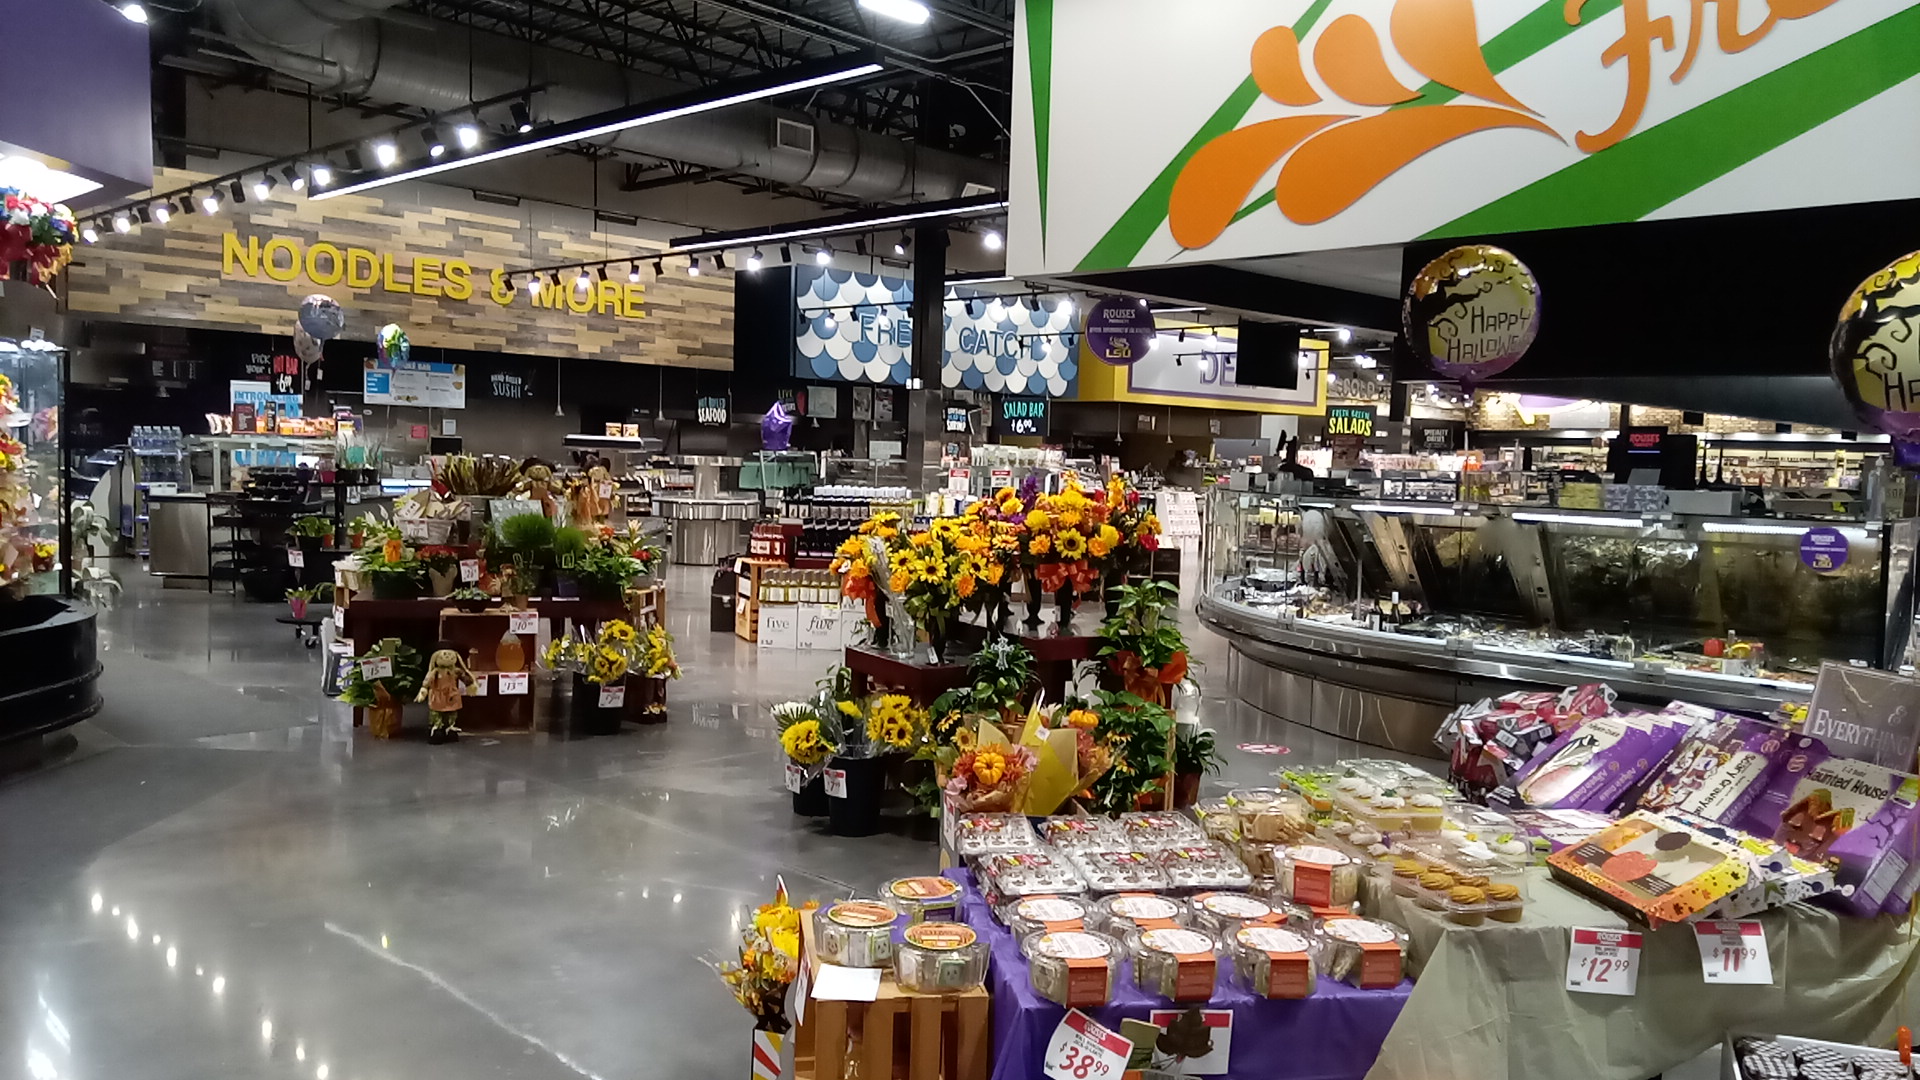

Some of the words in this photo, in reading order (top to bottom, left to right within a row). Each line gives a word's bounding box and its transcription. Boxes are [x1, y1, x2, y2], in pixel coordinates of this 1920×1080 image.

[222, 233, 473, 300] NOODLES
[490, 268, 515, 306] &
[531, 272, 647, 318] MORE
[1103, 308, 1136, 319] ROUSES
[1471, 305, 1532, 334] HAPPY
[858, 312, 912, 347] FRE
[959, 327, 1034, 361] CATCH
[1106, 348, 1131, 358] LSU
[493, 382, 521, 399] SUSHI
[698, 407, 727, 424] SEAFOOD
[1003, 401, 1027, 419] SALAD
[1029, 401, 1045, 418] BAR
[1328, 417, 1373, 436] SALADS
[1629, 433, 1660, 443] ROUSES
[766, 616, 790, 630] five
[806, 615, 835, 633] five
[1887, 704, 1908, 727] &
[1812, 708, 1910, 756] EVERYTHING
[1727, 753, 1757, 779] Scary
[1806, 767, 1852, 791] Haunted
[1851, 778, 1890, 801] House
